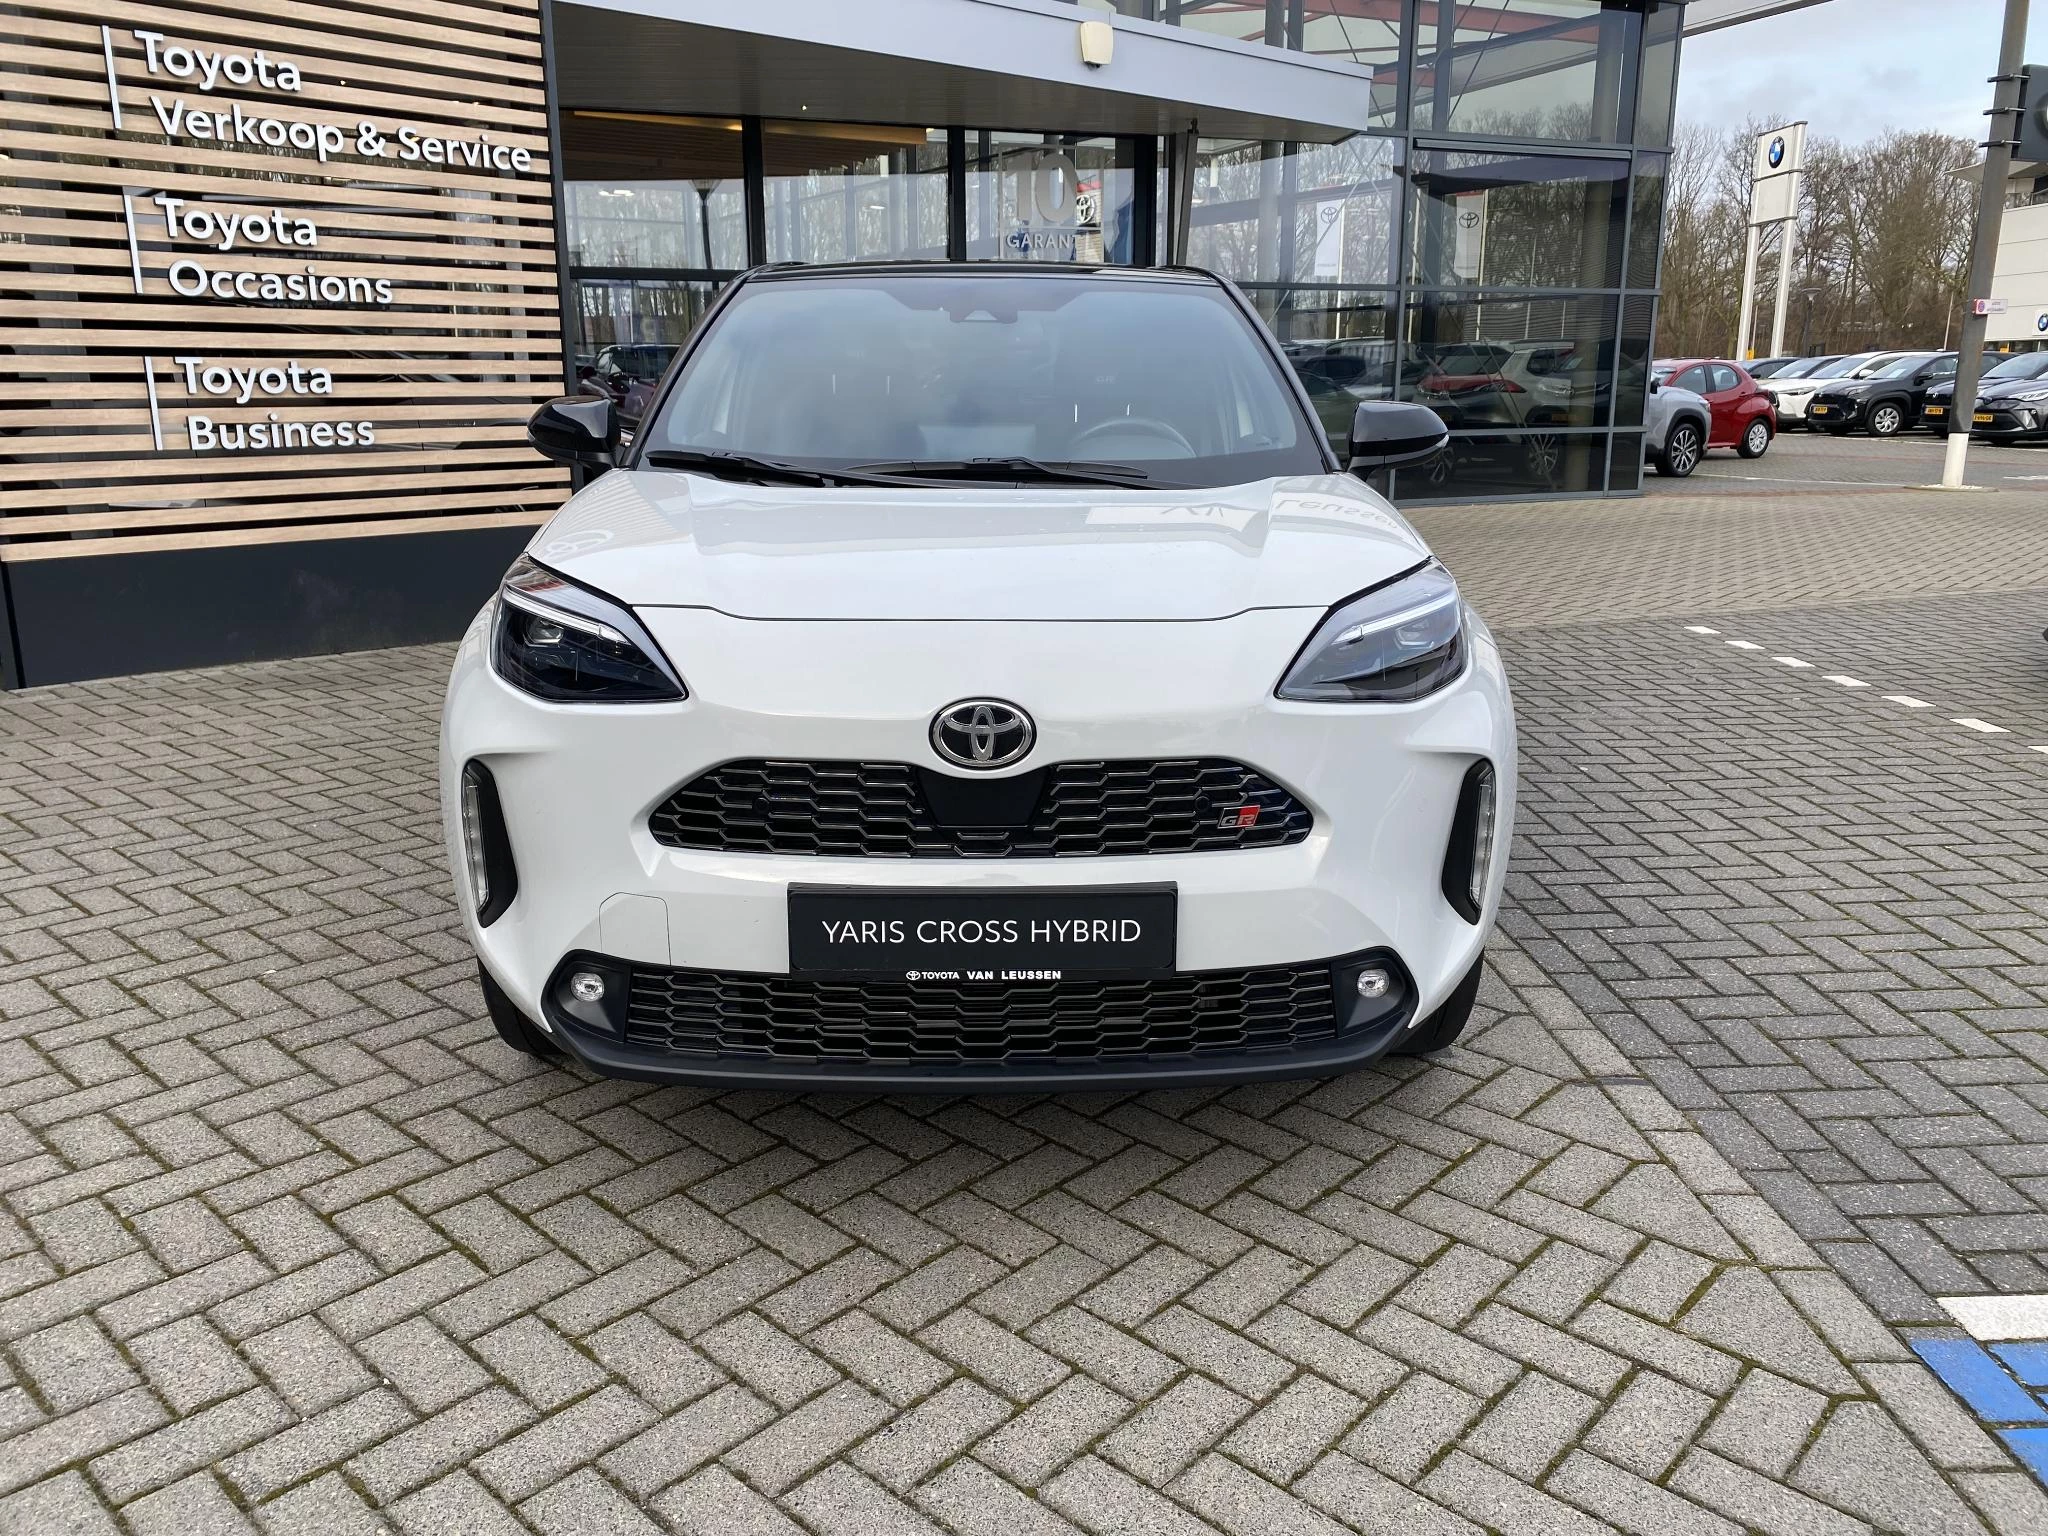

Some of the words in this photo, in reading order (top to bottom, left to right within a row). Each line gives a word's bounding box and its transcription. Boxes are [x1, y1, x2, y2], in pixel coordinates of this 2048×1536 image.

[134, 29, 302, 91] Toyota
[150, 96, 345, 162] Verkoop
[356, 120, 387, 158] &
[397, 126, 532, 172] Service
[1006, 152, 1078, 222] 10
[154, 197, 318, 251] Toyota
[168, 260, 393, 304] Occasions
[174, 356, 333, 404] Toyota
[187, 412, 375, 451] Business
[821, 919, 905, 943] YARIS
[916, 919, 1018, 943] CROSS
[1031, 919, 1142, 943] HYBRID
[921, 970, 960, 981] TOYOTA
[966, 970, 994, 981] VAN
[1001, 970, 1062, 981] LEUSSEN
